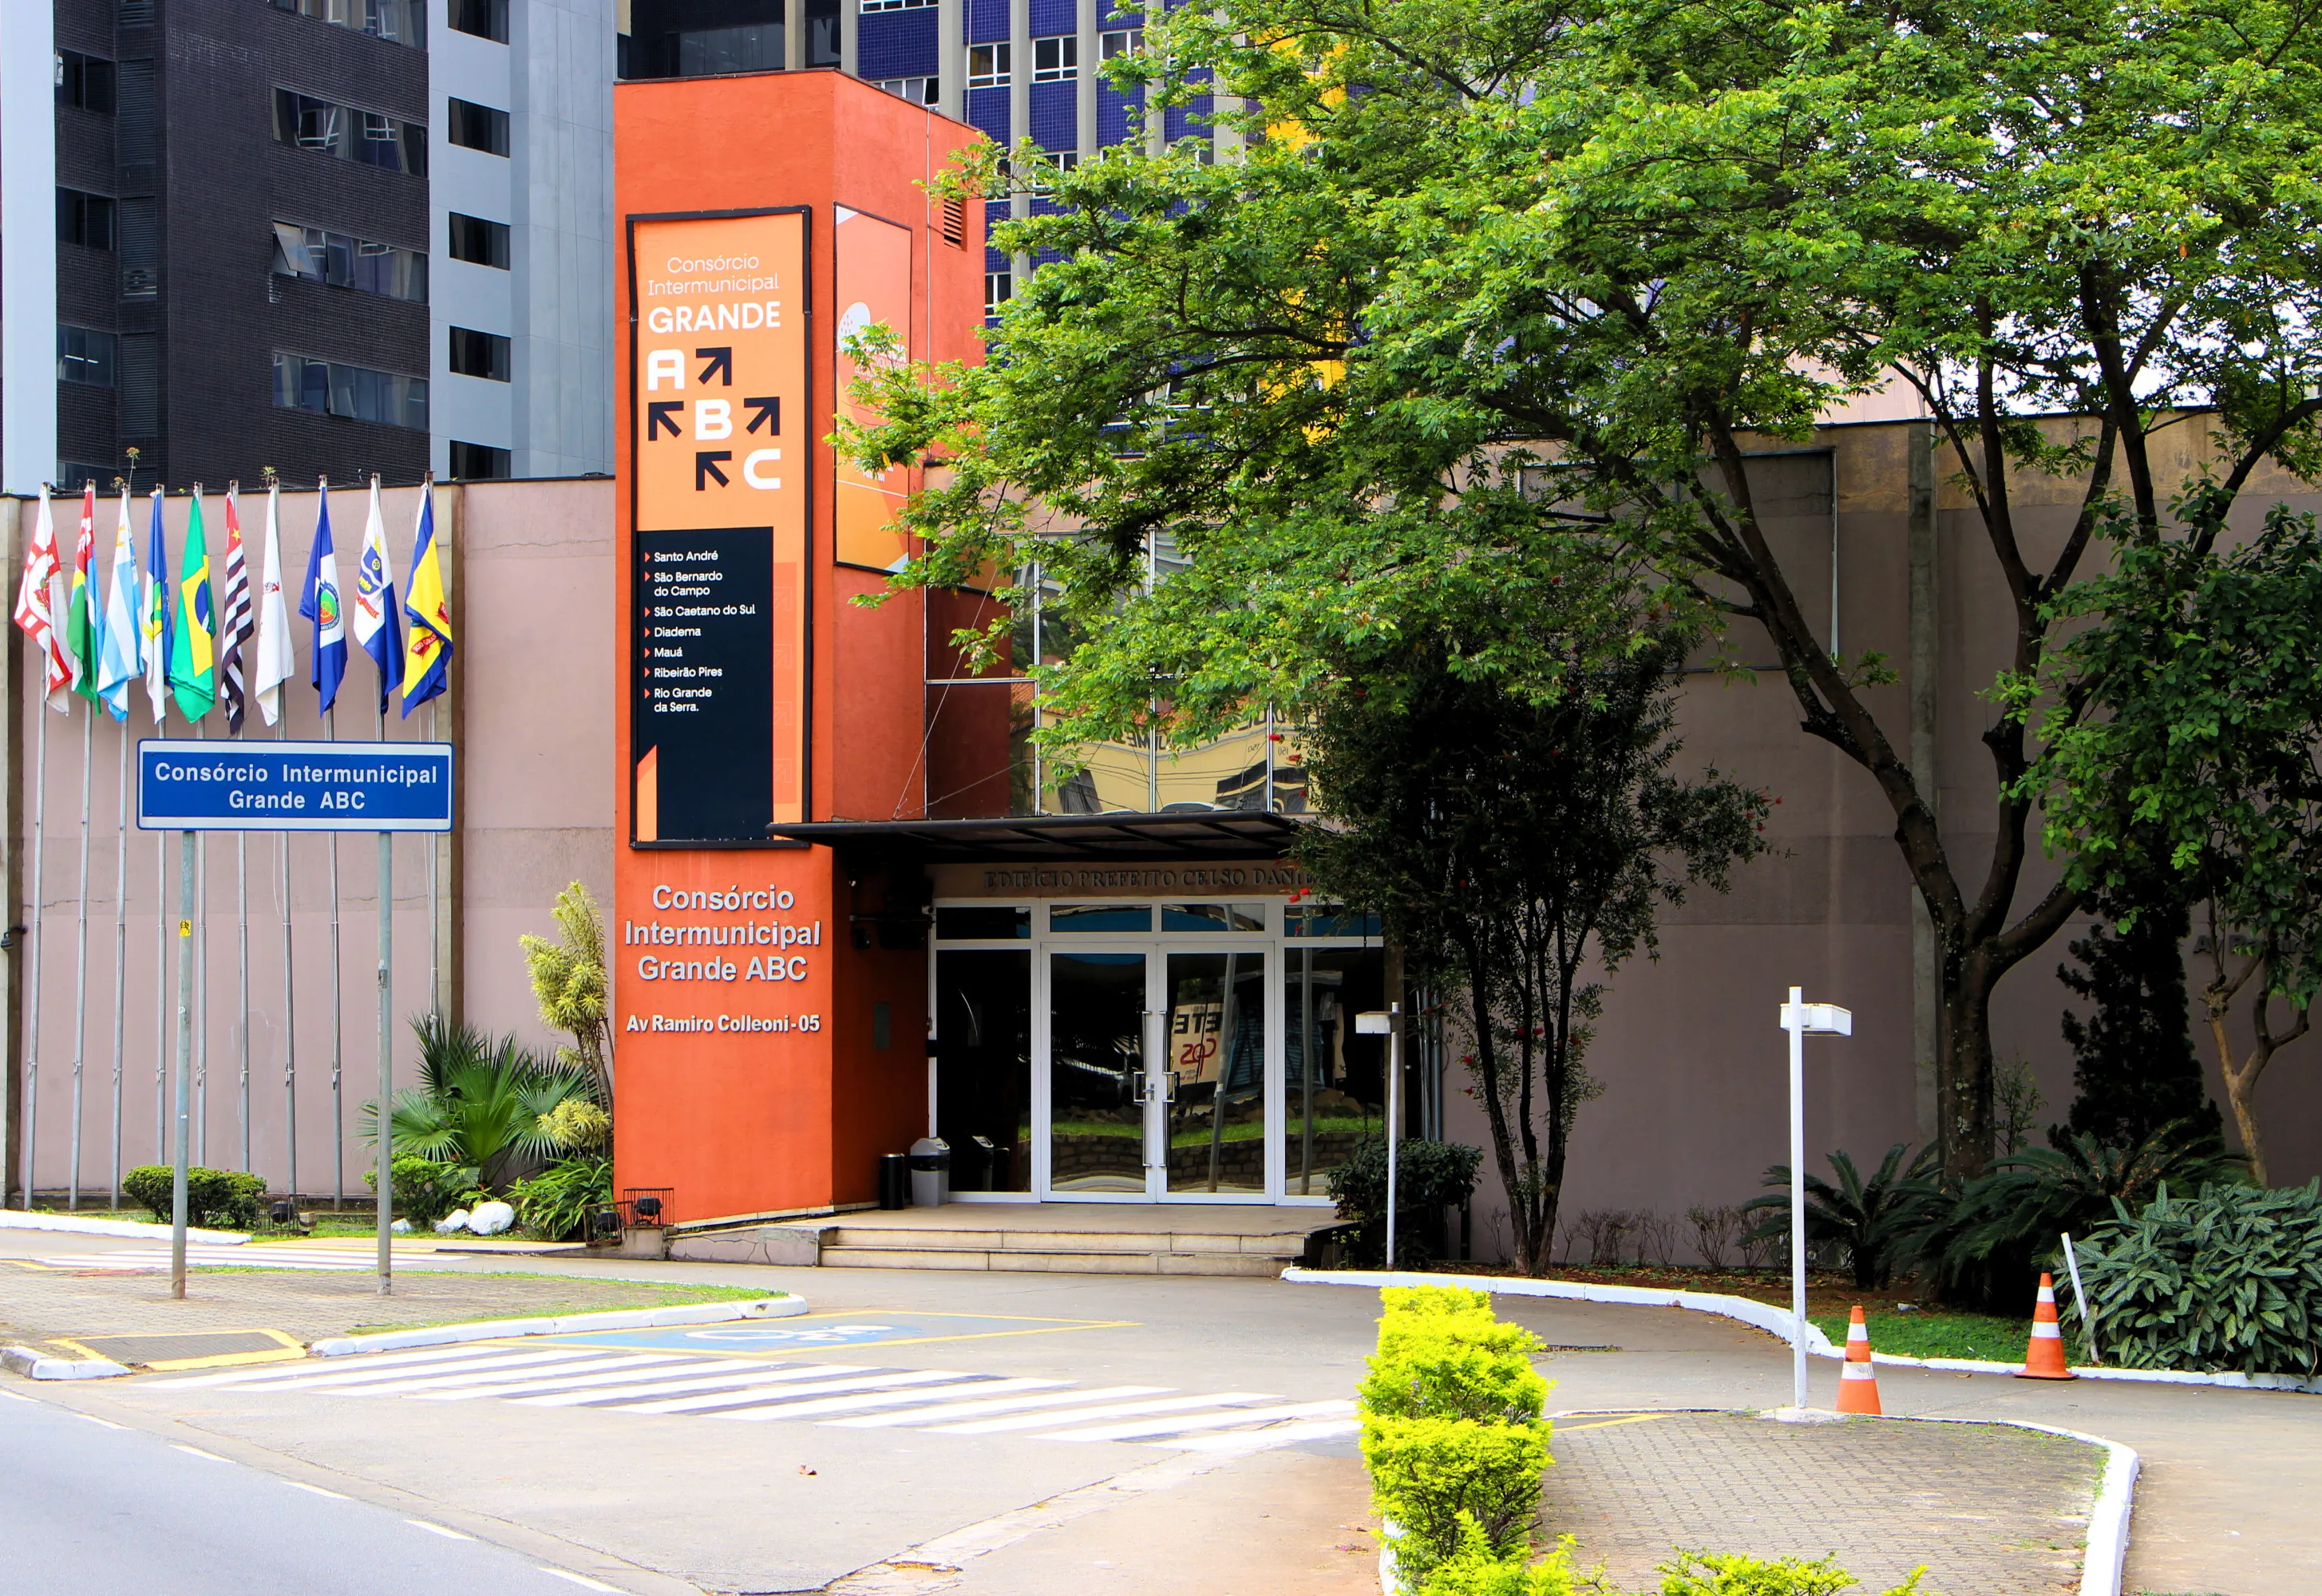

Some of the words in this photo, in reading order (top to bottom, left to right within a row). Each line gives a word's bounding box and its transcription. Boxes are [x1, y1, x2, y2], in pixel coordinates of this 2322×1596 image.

[667, 254, 759, 274] Consórcio
[648, 273, 779, 296] Intermunicipal
[648, 301, 781, 334] GRANDE
[647, 349, 685, 391] A
[695, 399, 733, 440] B
[743, 448, 781, 490] C
[654, 551, 684, 562] Santo
[686, 550, 718, 562] André
[654, 571, 674, 583] São
[675, 571, 723, 582] Bernardo
[654, 587, 669, 597] do
[670, 586, 710, 598] Campo
[654, 606, 674, 617] São
[675, 606, 721, 616] Caetano
[722, 605, 738, 615] do
[739, 604, 756, 614] Sul
[654, 626, 702, 637] Diadema
[654, 647, 682, 658] Mauá
[654, 667, 696, 678] Ribeirão
[698, 666, 722, 678] Pires
[654, 688, 670, 698] Rio
[672, 687, 712, 698] Grande
[654, 702, 668, 713] da
[670, 702, 699, 713] Serra.
[155, 762, 268, 782] Consórcio
[283, 764, 437, 787] Intermunicipal
[229, 790, 306, 809] Grande
[320, 791, 366, 810] ABC
[1078, 869, 1177, 887] PREFEITO
[1181, 868, 1245, 887] CELSO
[1252, 868, 1323, 886] DANIE
[653, 884, 794, 911] Consórcio
[625, 920, 821, 950] Intermunicipal
[638, 955, 737, 982] Grande
[745, 956, 808, 982] ABC
[627, 1015, 649, 1032] Av
[652, 1014, 714, 1033] Ramiro
